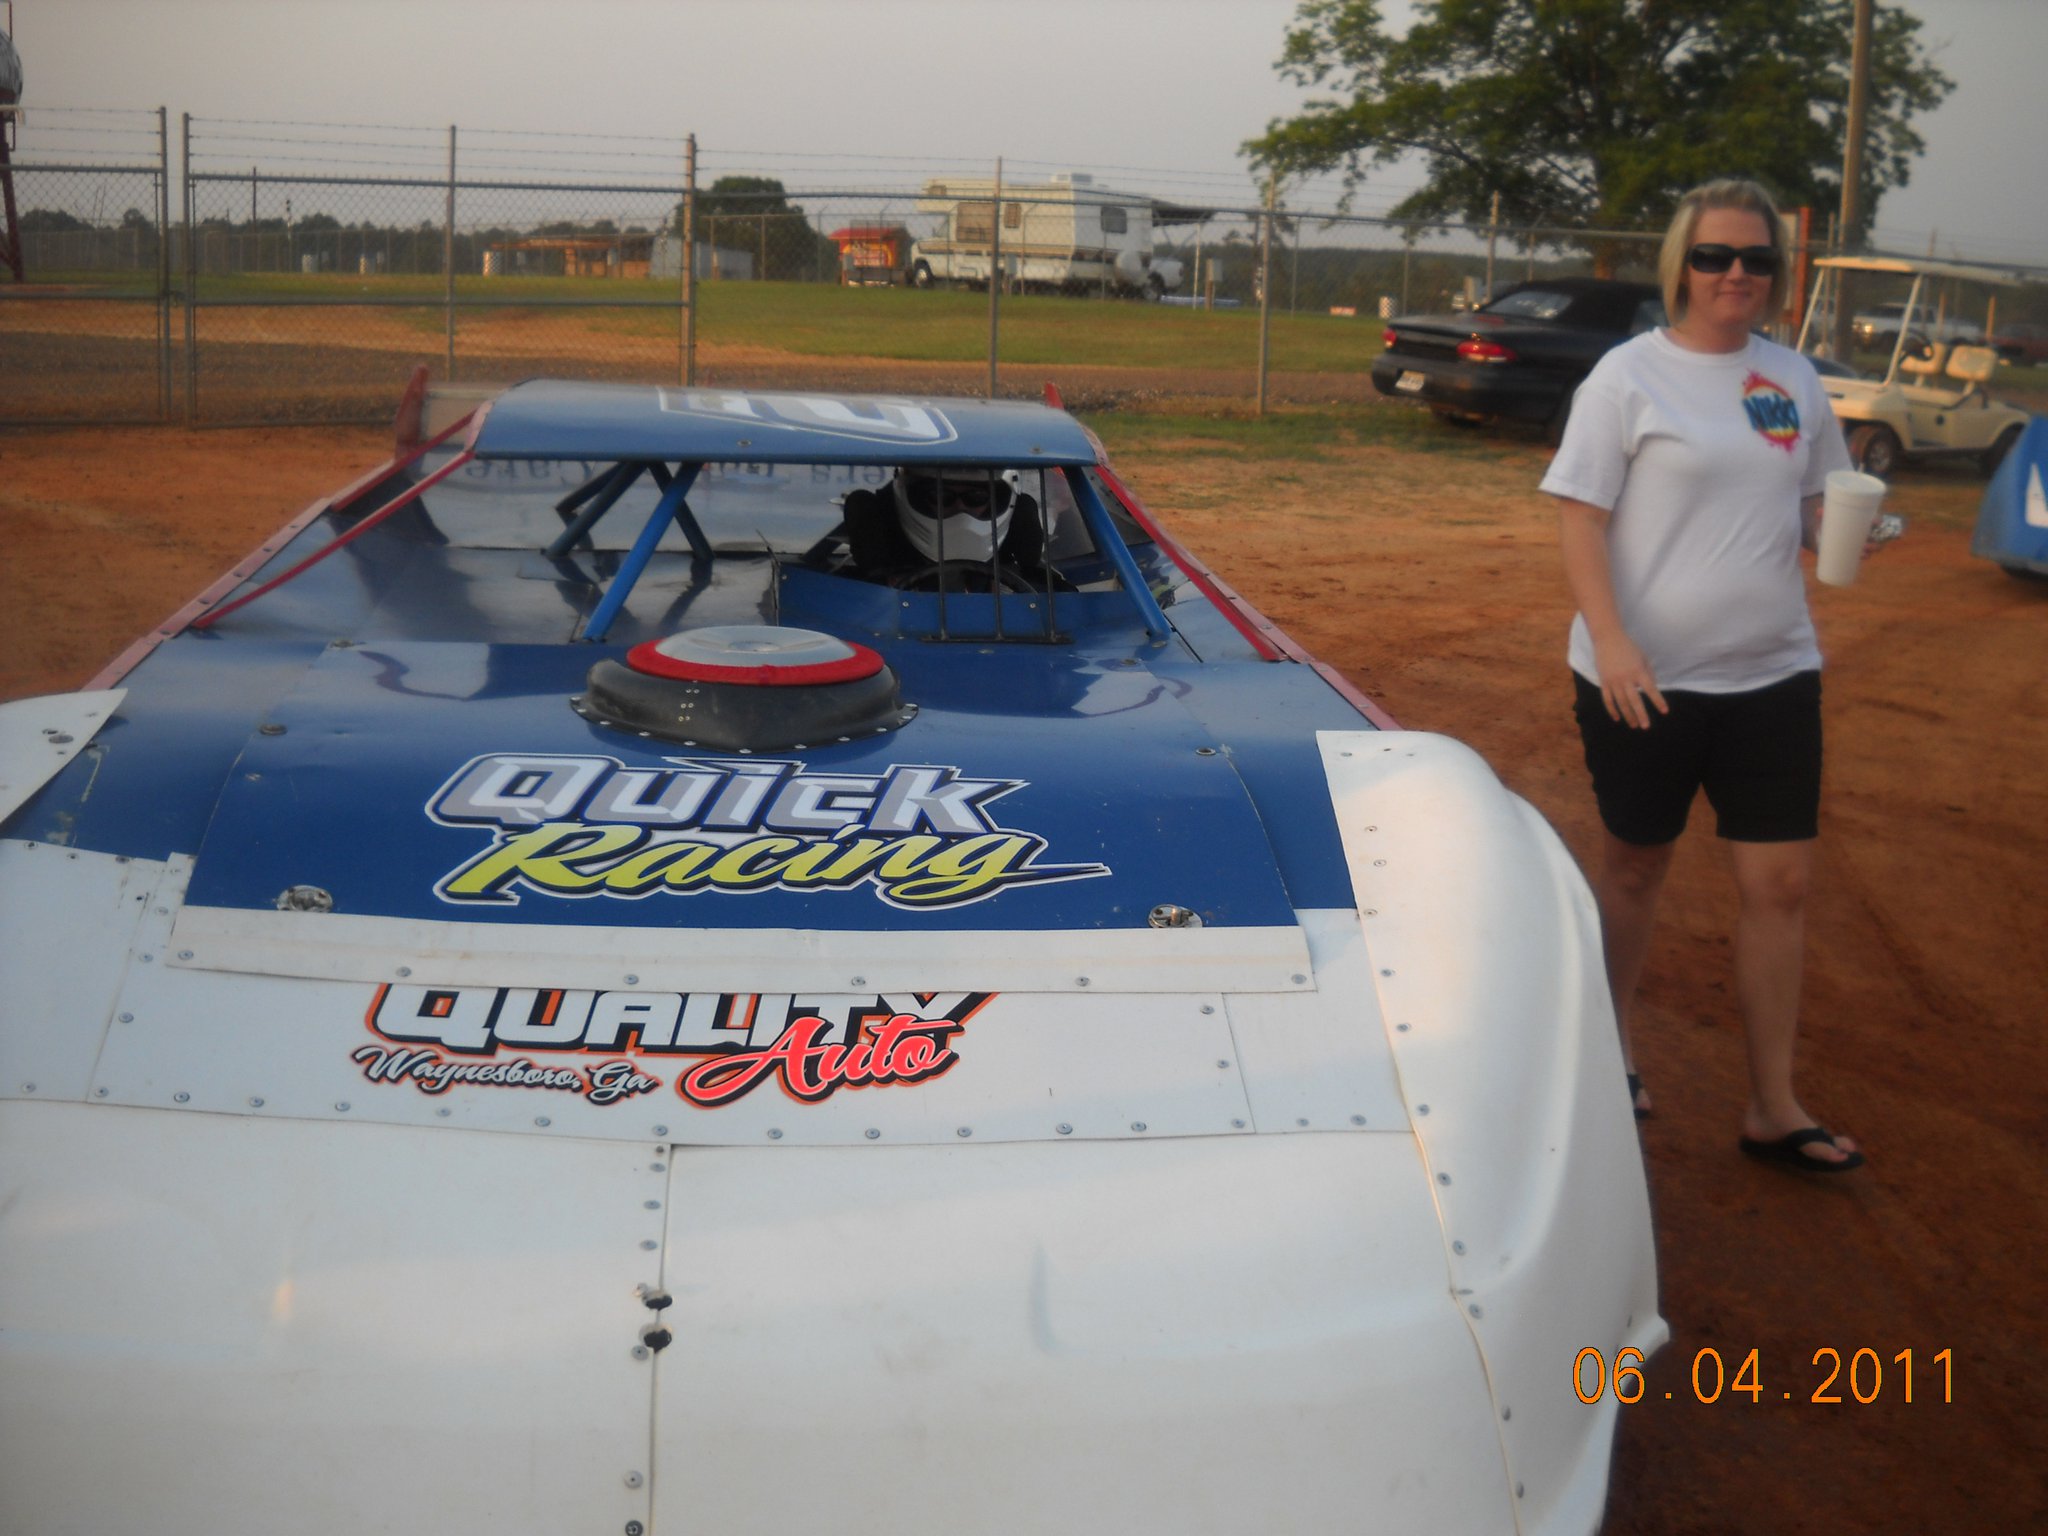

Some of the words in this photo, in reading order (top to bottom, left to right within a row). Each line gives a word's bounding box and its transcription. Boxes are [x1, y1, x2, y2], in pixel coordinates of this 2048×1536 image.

[440, 821, 1110, 908] Racing
[352, 1045, 584, 1094] Waynesboro,
[585, 1060, 662, 1106] Ga
[678, 1012, 964, 1108] Auto
